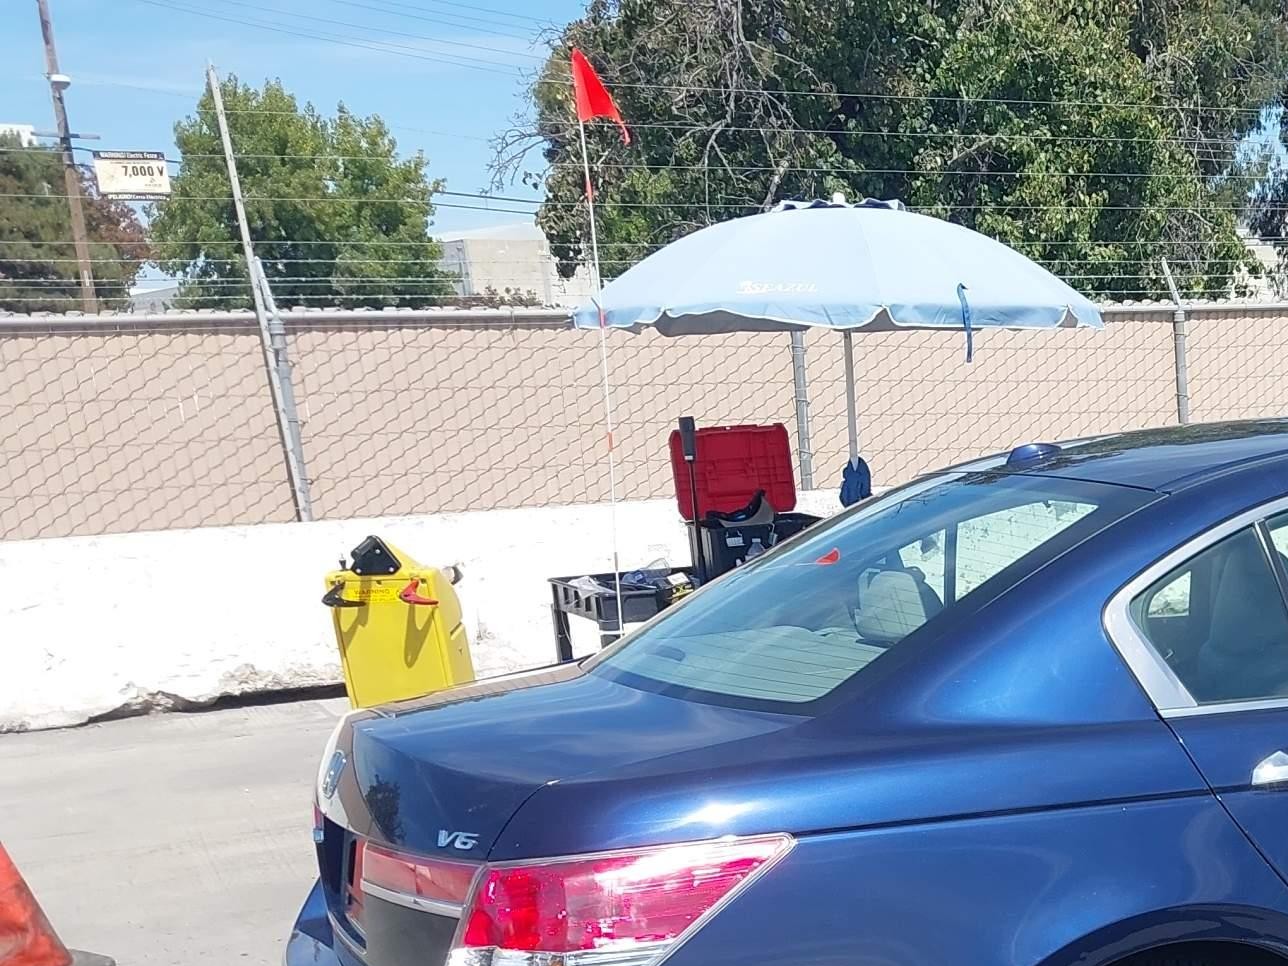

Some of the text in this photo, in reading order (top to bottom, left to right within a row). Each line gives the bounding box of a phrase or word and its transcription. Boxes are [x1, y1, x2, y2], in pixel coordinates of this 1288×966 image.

[121, 165, 164, 178] 7,000 V
[437, 829, 480, 850] V6
